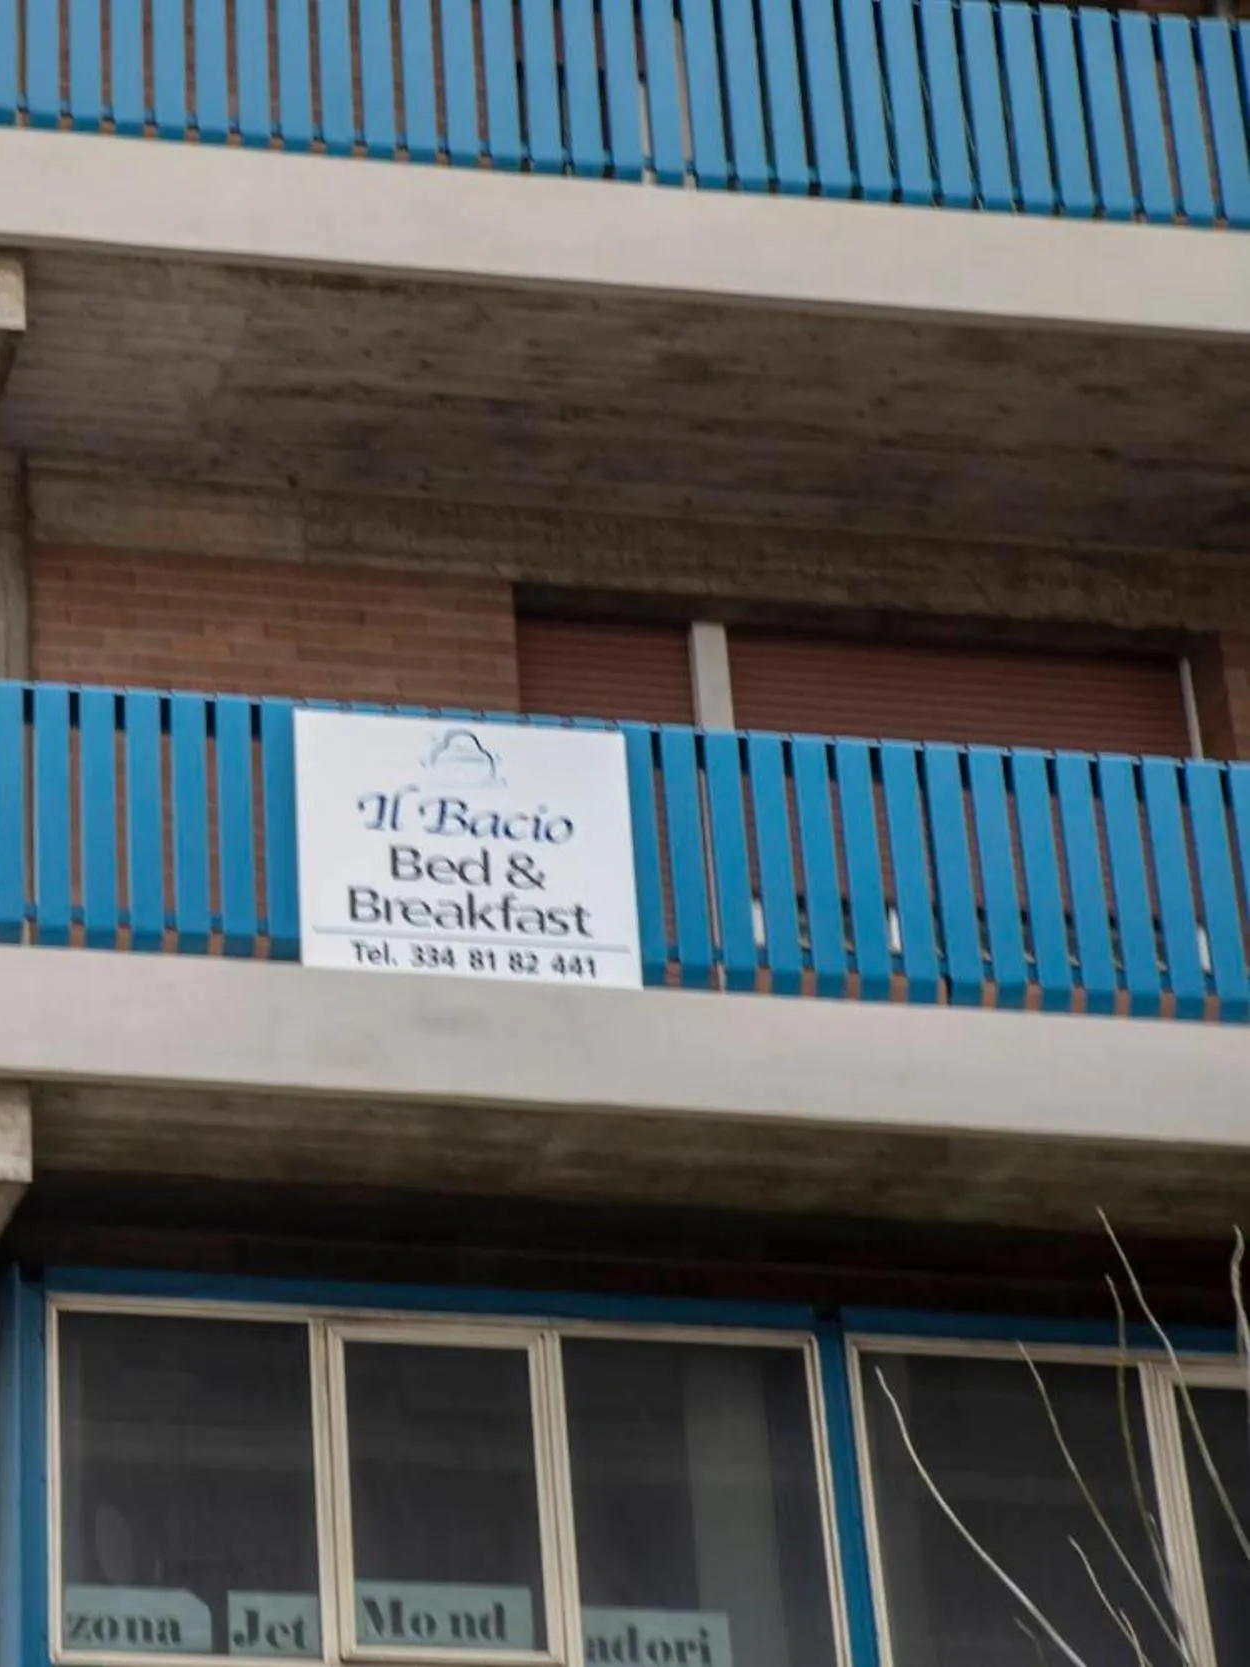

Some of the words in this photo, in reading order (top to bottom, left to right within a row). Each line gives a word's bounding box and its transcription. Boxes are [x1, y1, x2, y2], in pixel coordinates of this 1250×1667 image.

[357, 784, 419, 832] Il
[419, 797, 574, 845] Bacio
[389, 844, 492, 887] Bed
[506, 852, 545, 891] &
[348, 885, 593, 938] Breakfast
[350, 940, 399, 967] Tel.
[411, 943, 456, 970] 334
[468, 948, 496, 973] 81
[508, 951, 540, 976] 82
[551, 954, 597, 979] 441
[232, 1606, 309, 1650] Jet
